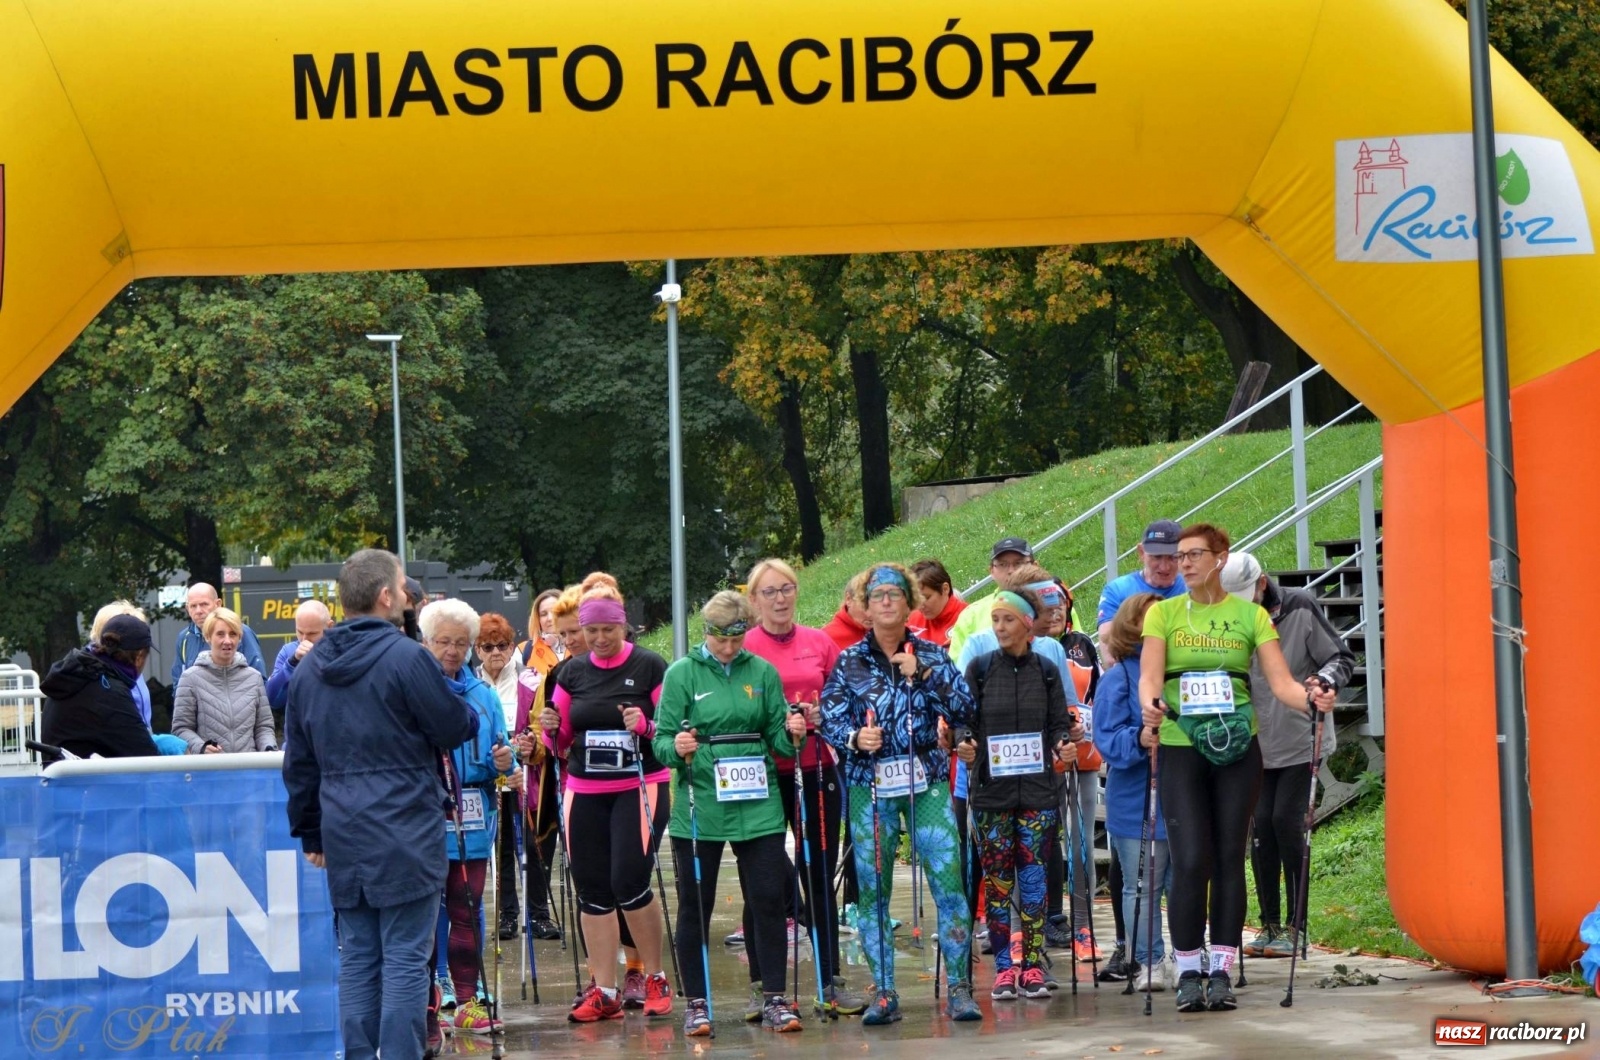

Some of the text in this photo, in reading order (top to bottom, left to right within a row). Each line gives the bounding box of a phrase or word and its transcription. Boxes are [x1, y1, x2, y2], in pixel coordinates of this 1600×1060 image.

[294, 19, 1097, 120] MIASTO RACIBÓRZ
[1364, 185, 1577, 259] Raciórz
[1190, 682, 1220, 696] 011
[1002, 743, 1030, 758] 021
[730, 767, 756, 782] 009
[884, 762, 911, 778] 010
[462, 798, 475, 813] 03
[0, 852, 299, 980] LON
[167, 990, 299, 1017] RYBNIK
